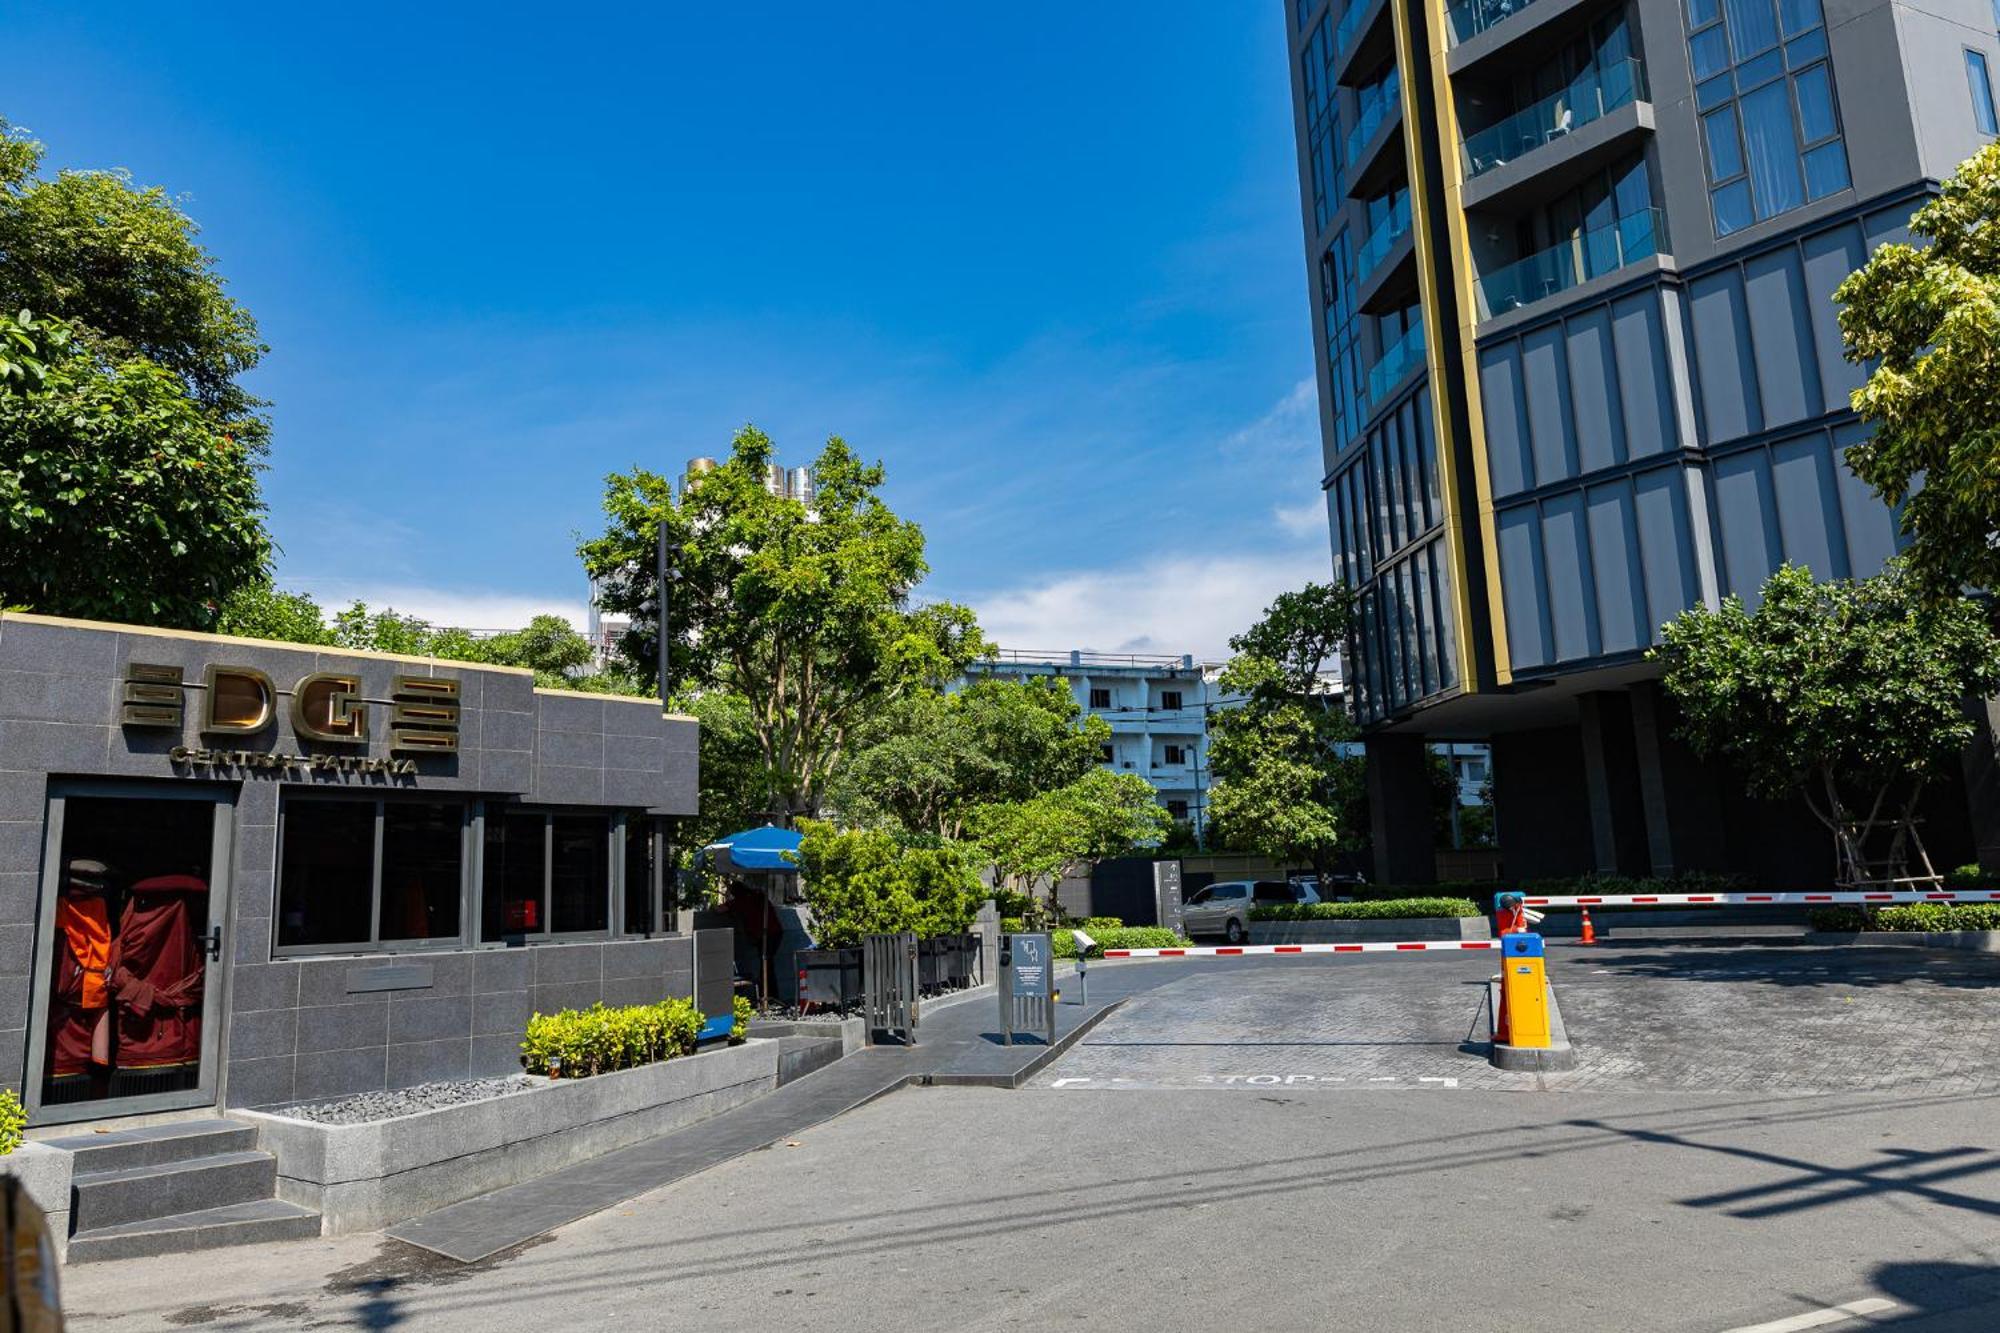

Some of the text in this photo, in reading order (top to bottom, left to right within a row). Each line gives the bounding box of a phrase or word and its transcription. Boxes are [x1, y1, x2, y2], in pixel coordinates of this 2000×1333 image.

[122, 662, 462, 752] EDGE
[170, 745, 418, 773] CENTRAL PATTAYA
[1196, 1074, 1316, 1085] STOP
